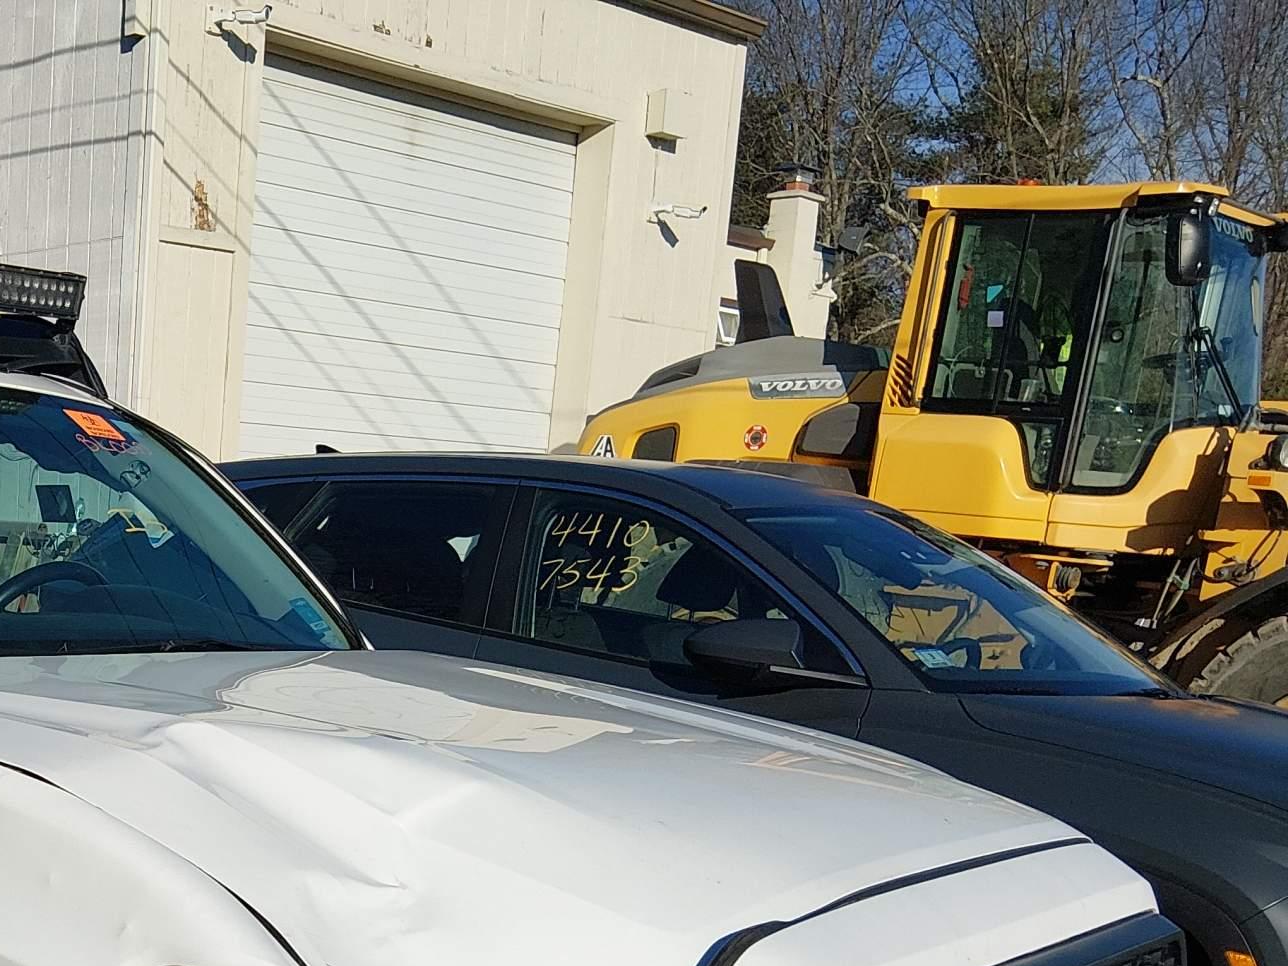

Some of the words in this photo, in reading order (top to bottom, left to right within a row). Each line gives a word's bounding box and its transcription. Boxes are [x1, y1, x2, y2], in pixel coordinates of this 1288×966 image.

[1212, 216, 1254, 243] VOLVO
[759, 378, 842, 393] VOLVO
[551, 511, 650, 549] 4410
[539, 554, 639, 592] 7543
